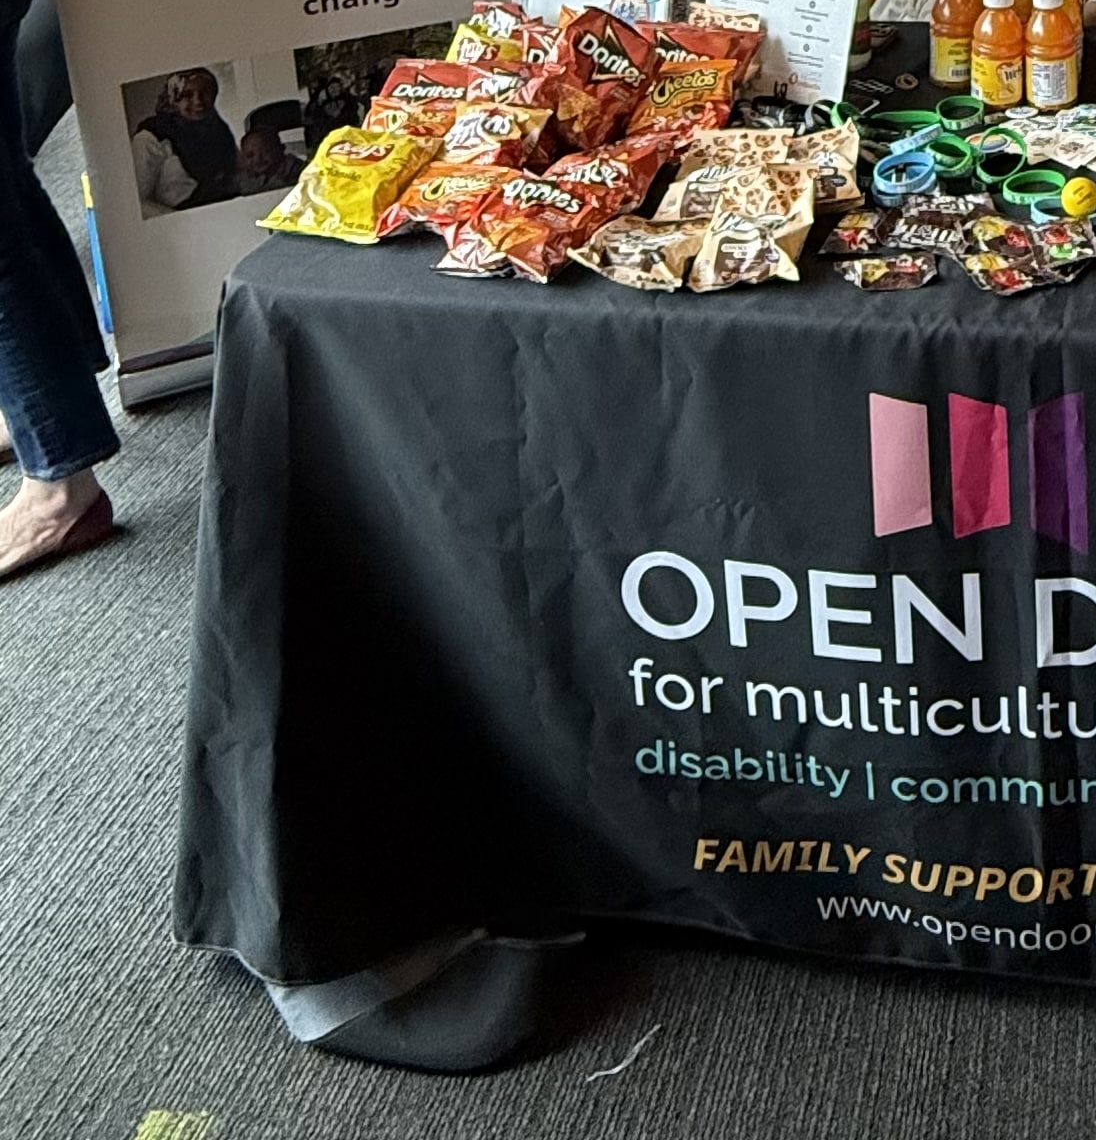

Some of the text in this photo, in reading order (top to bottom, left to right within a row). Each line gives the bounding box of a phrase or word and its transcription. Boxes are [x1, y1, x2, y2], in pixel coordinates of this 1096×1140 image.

[577, 33, 647, 88] Doritos
[391, 82, 466, 99] Doritos
[652, 70, 718, 106] Cheetos
[502, 177, 582, 213] Doritos
[621, 551, 983, 665] OPEN
[628, 658, 723, 714] for
[635, 739, 850, 798] disability
[694, 838, 871, 875] FAMILY
